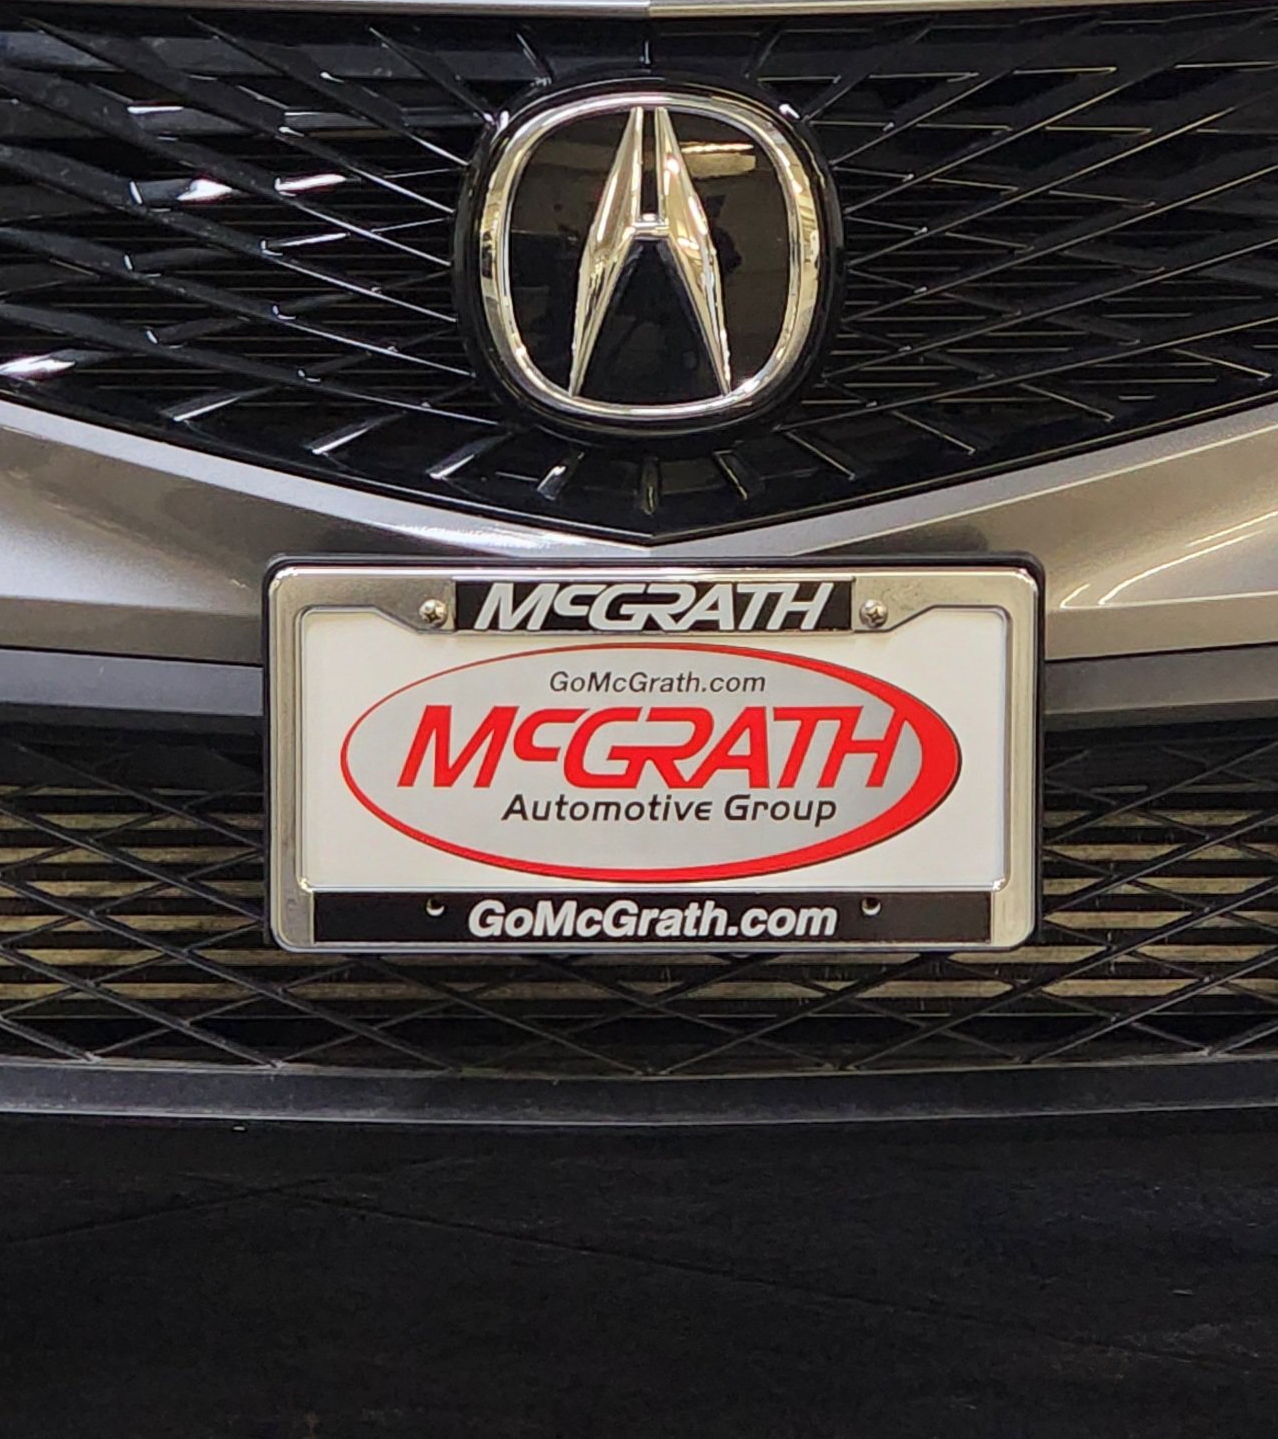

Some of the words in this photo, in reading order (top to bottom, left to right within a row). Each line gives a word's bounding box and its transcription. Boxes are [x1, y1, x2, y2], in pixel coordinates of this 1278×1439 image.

[548, 670, 766, 694] GoMcGrath.com
[501, 794, 712, 822] Automotive
[724, 794, 837, 828] Group
[467, 898, 837, 938] GoMcGrath.com
